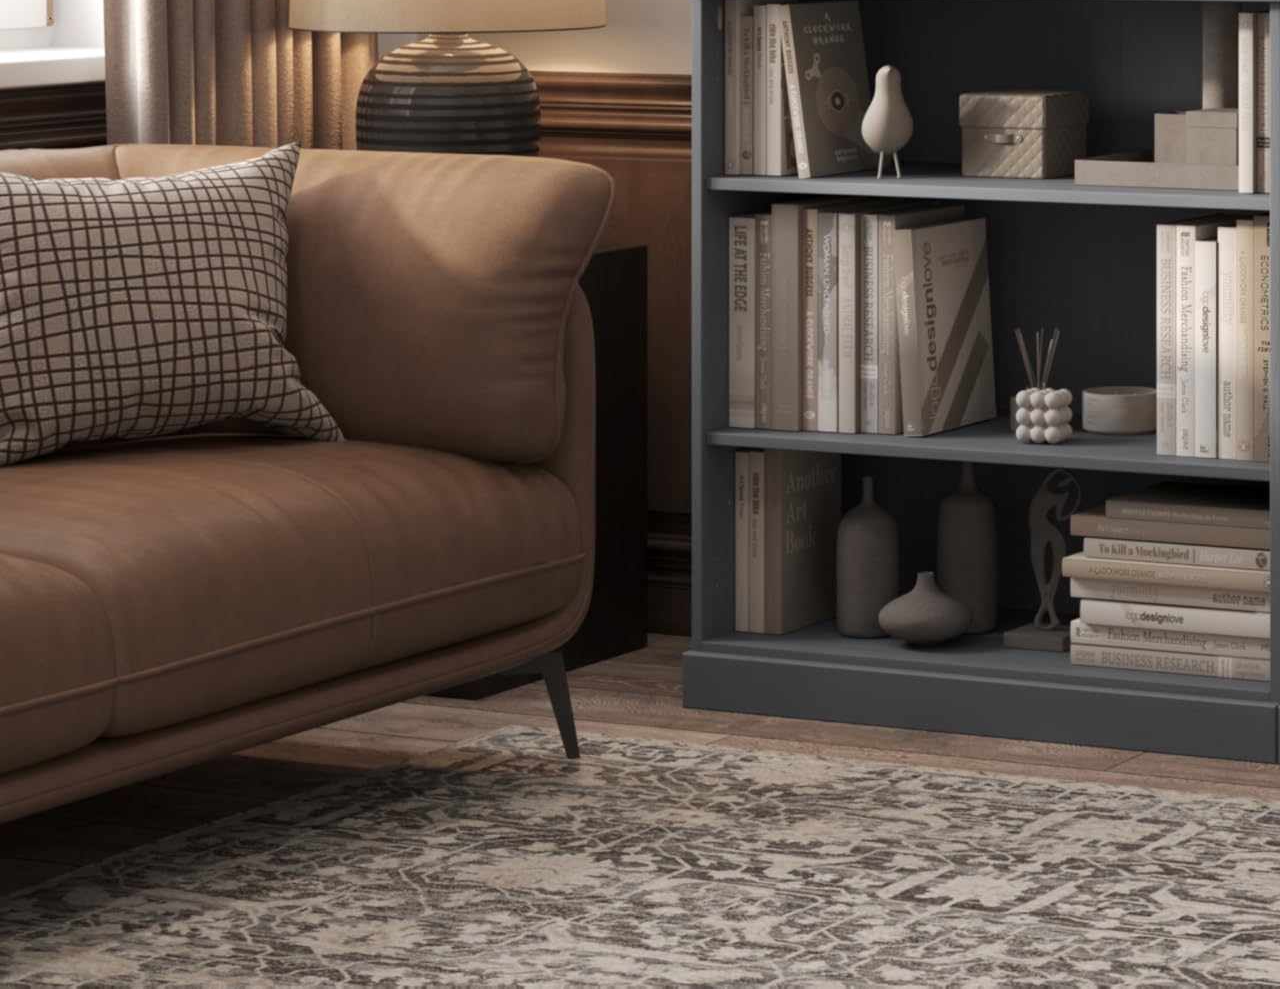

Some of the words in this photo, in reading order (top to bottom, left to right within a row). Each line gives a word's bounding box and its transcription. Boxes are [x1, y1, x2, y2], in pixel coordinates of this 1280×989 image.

[734, 225, 748, 246] LIFE
[734, 247, 748, 261] AT
[757, 252, 771, 285] Fashion
[734, 262, 748, 284] THE
[863, 247, 873, 301] BUSINESS
[1160, 259, 1171, 315] BUSINESS
[1178, 266, 1192, 301] Fashion
[734, 285, 748, 311] EDGE
[1259, 254, 1269, 332] ECONOMETRICS
[757, 287, 771, 353] Merchandising
[863, 302, 873, 362] RESEARCH
[1160, 316, 1171, 380] RESEARCH
[1178, 303, 1192, 373] Merchandising
[1223, 380, 1233, 412] author
[1223, 413, 1233, 438] name
[785, 467, 839, 493] Another
[785, 504, 808, 524] Art
[785, 532, 817, 555] Book
[1107, 629, 1141, 642] Fashion
[1143, 631, 1208, 651] Merchandising
[1101, 652, 1153, 669] BUSINESS
[1155, 656, 1215, 674] RESEARCH
